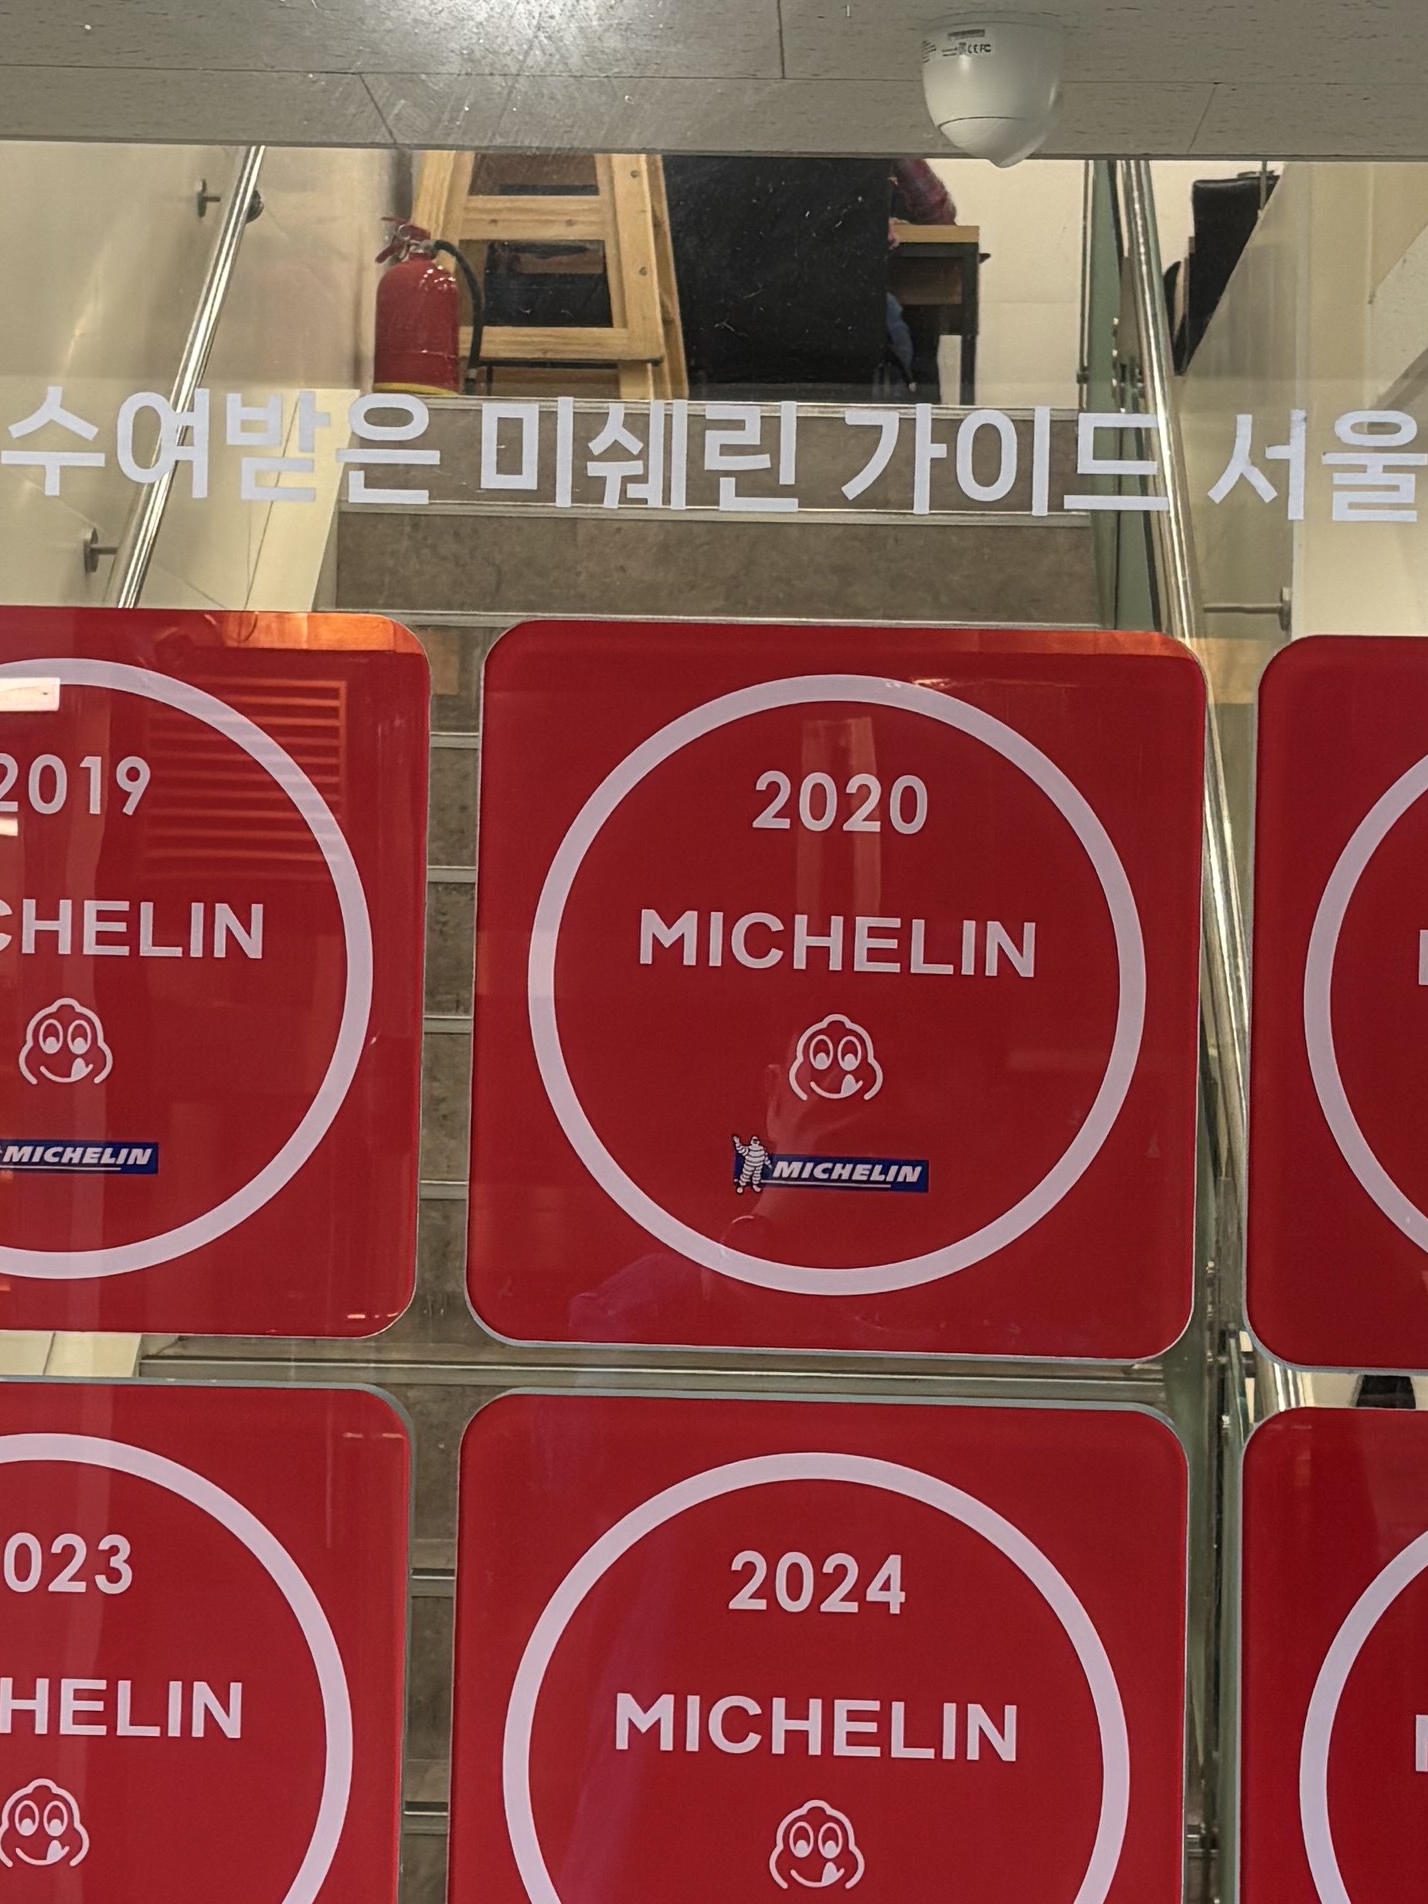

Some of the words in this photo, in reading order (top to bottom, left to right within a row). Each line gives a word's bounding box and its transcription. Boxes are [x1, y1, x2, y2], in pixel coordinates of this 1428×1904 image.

[0, 385, 441, 505] 수여받은
[481, 397, 798, 512] 미쉐린
[842, 403, 1170, 516] 가이드
[1208, 409, 1428, 523] 서울
[752, 770, 928, 835] 2020
[639, 908, 1036, 977] MICHELIN
[2, 1144, 151, 1167] MICHELIN
[772, 1160, 921, 1185] MICHELIN
[728, 1550, 905, 1614] 2024
[615, 1692, 1016, 1762] MICHELIN
